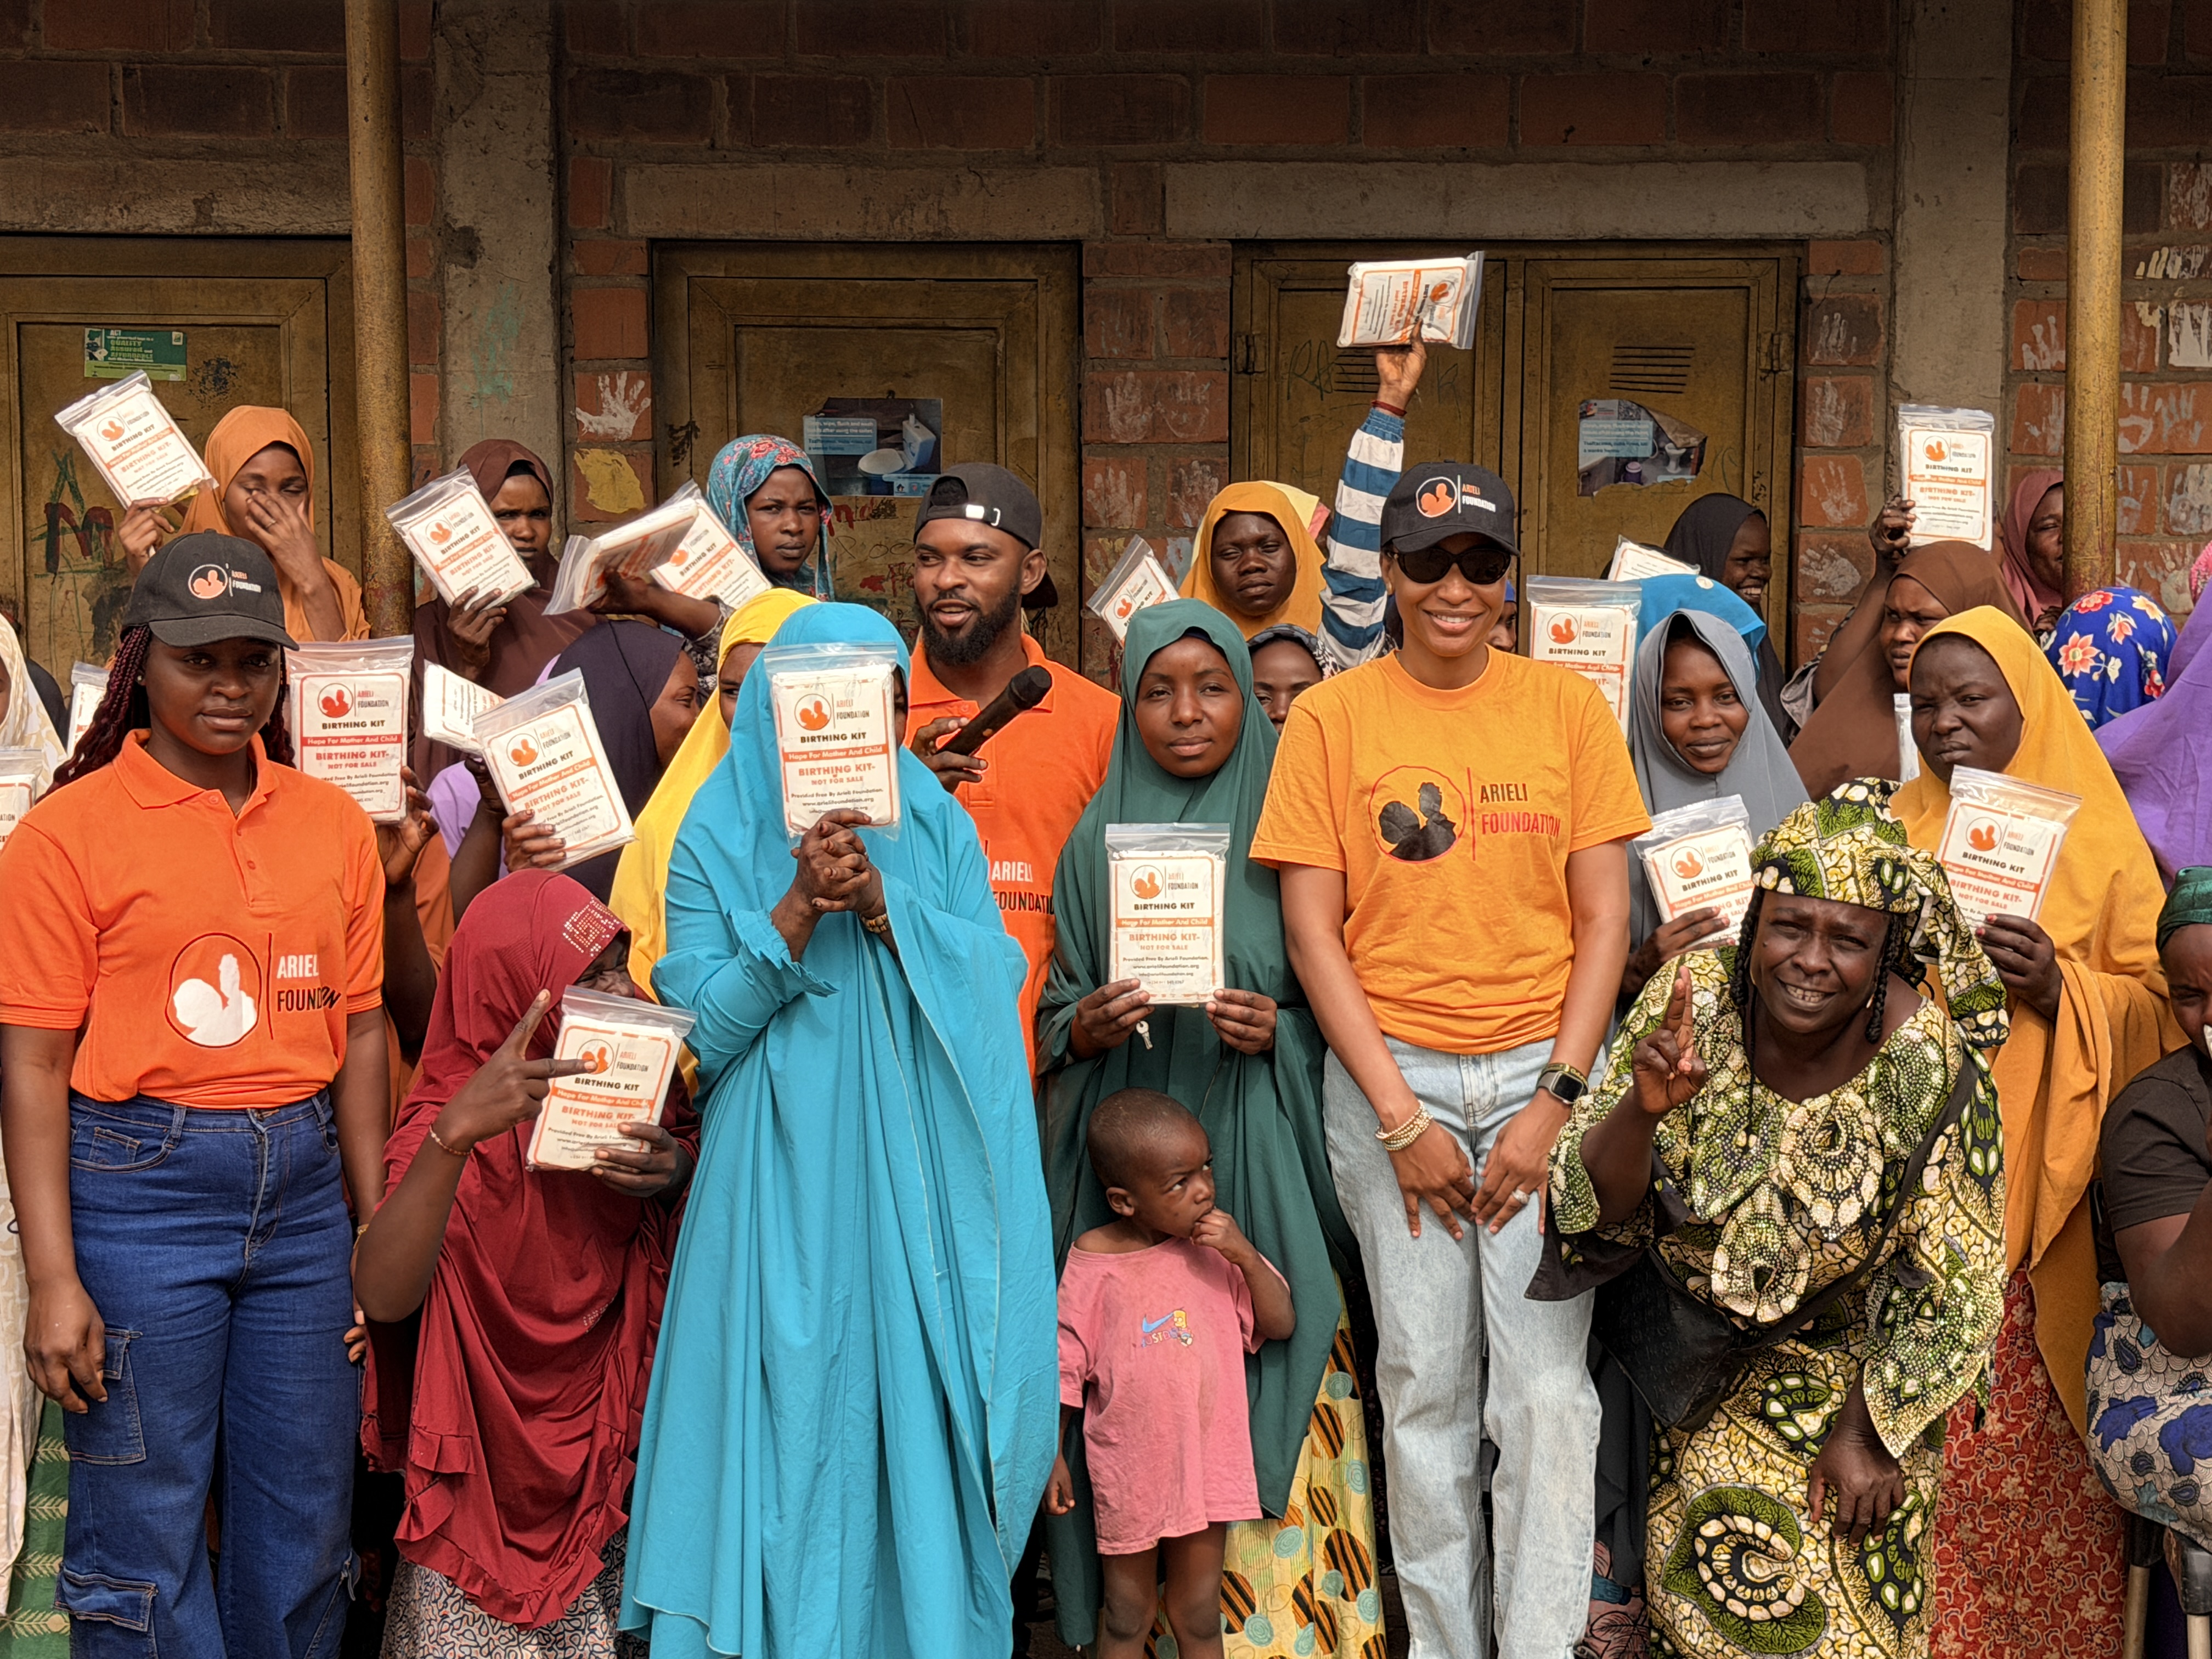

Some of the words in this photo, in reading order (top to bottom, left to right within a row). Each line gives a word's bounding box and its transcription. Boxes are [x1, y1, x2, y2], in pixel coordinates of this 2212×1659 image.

[111, 431, 143, 451] BIRTHING
[143, 424, 155, 433] KIT
[121, 450, 156, 472] BIRTHING
[1462, 483, 1481, 495] ARIELI
[1462, 495, 1496, 512] FOUNDATION
[441, 534, 470, 555] BIRTHING
[470, 526, 479, 535] KIT
[449, 553, 483, 575] BIRTHING
[680, 552, 707, 576] BIRTHING
[706, 543, 717, 552] KIT
[1549, 647, 1589, 656] BIRTHING
[837, 710, 870, 719] FOUNDATION
[541, 731, 572, 749] FOUNDATION
[801, 733, 847, 743] BIRTHING
[317, 752, 365, 760] BIRTHING
[518, 758, 558, 780] BIRTHING
[559, 751, 574, 763] KIT
[798, 765, 851, 776] BIRTHING
[528, 782, 539, 791] For
[539, 774, 561, 787] Mother
[561, 768, 574, 778] And
[573, 761, 591, 772] Child
[523, 786, 567, 808] BIRTHING
[1480, 783, 1528, 803] ARIELI
[538, 804, 550, 813] NOT
[551, 799, 564, 807] FOR
[1482, 811, 1561, 838] FOUNDATION
[2004, 841, 2035, 855] FOUNDATION
[1962, 851, 2007, 868] BIRTHING
[2010, 863, 2025, 873] KIT
[991, 861, 1034, 883] ARIELI
[1681, 874, 1722, 891] BIRTHING
[1725, 870, 1739, 879] KIT
[1950, 879, 1999, 898] BIRTHING
[993, 891, 1054, 915] FOUNDATIO
[1959, 893, 1973, 901] NOT
[1992, 901, 2008, 909] SALE
[277, 954, 319, 979] ARIEL
[619, 1051, 637, 1061] ARIELI
[617, 1061, 649, 1073] FOUNDATION
[575, 1076, 622, 1090] BIRTHING
[624, 1082, 640, 1091] KIT
[557, 1090, 577, 1099] Hope
[590, 1095, 614, 1103] Mother
[561, 1105, 613, 1119] BIRTHING
